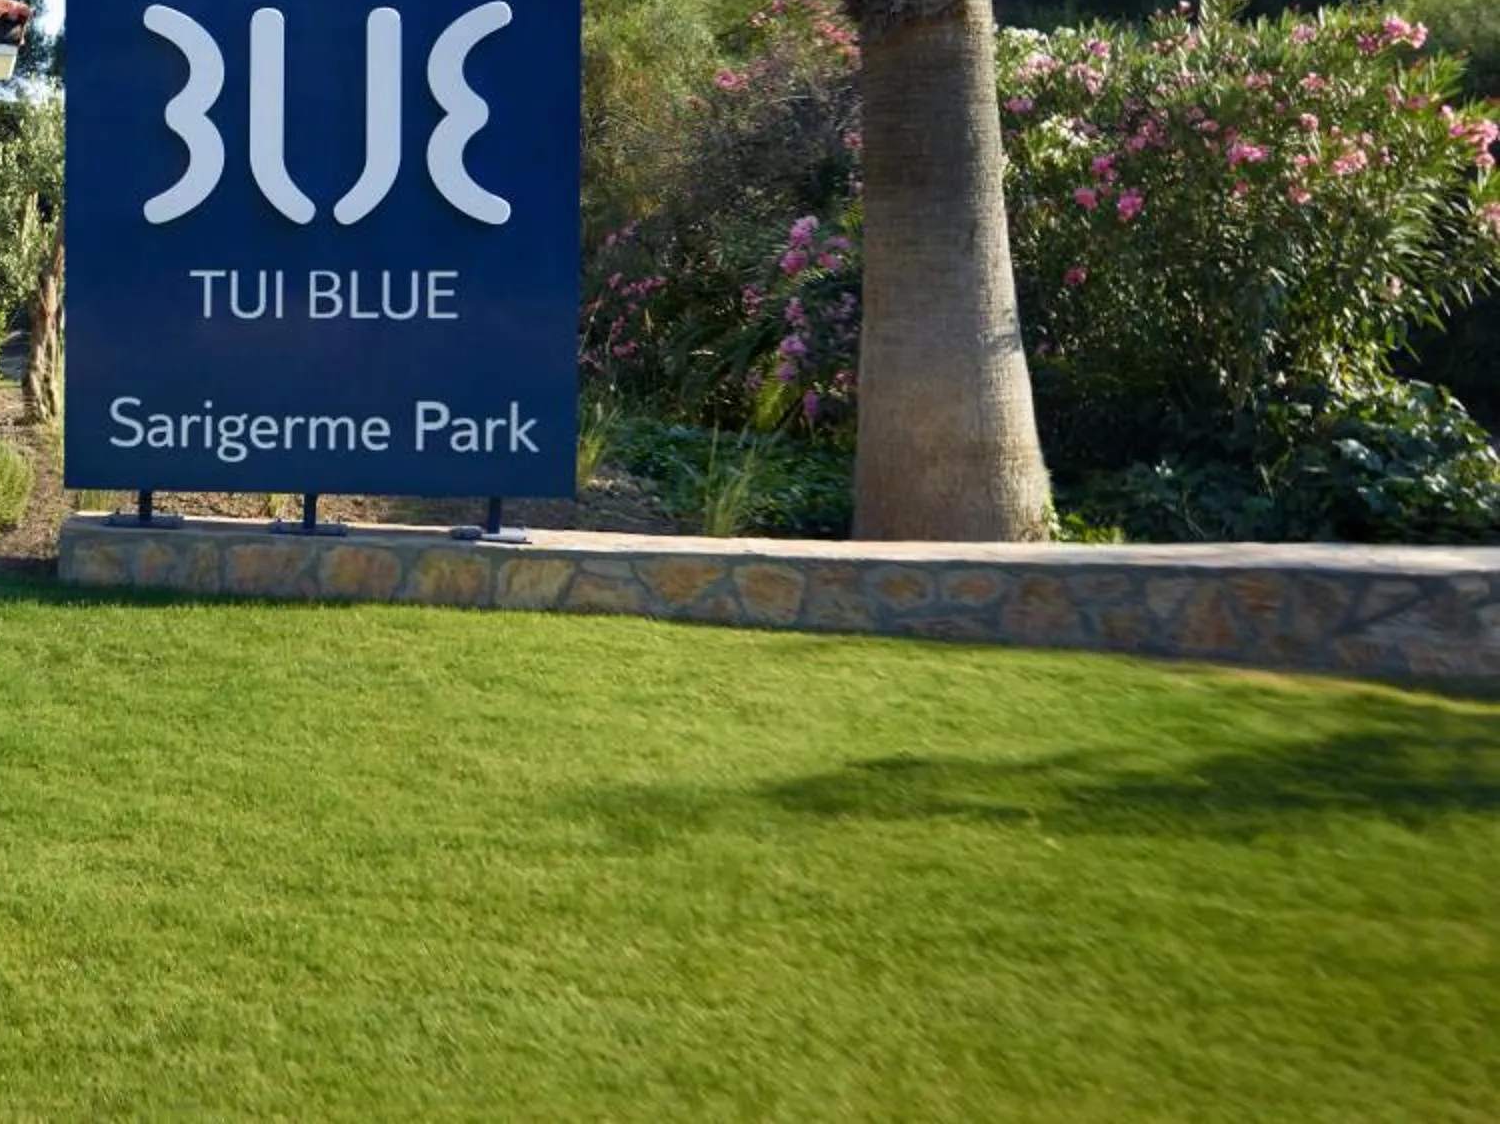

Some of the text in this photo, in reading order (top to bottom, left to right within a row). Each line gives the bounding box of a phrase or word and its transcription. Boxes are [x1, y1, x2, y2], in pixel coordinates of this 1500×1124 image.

[189, 270, 459, 319] TUI BLUE
[108, 396, 540, 463] Sarigerme Park
